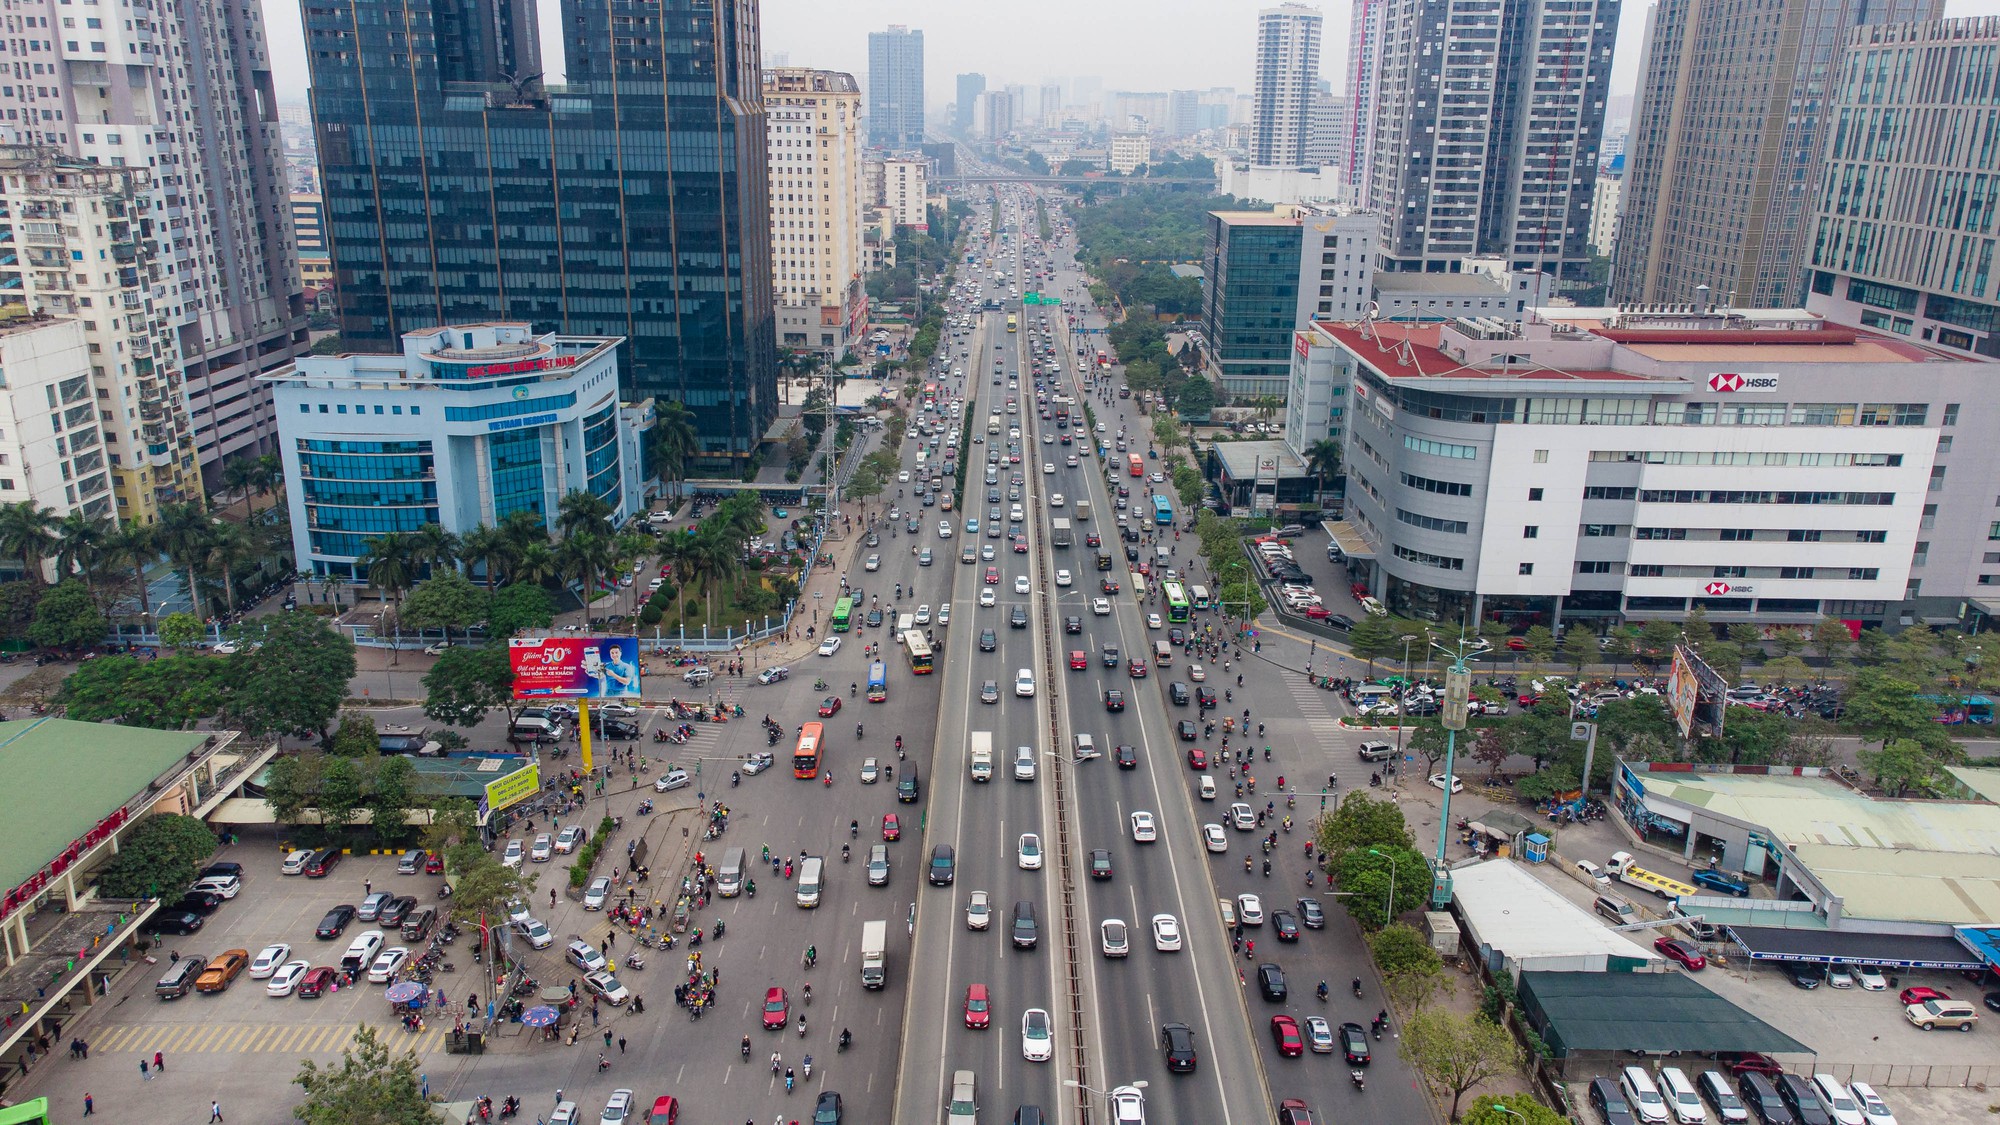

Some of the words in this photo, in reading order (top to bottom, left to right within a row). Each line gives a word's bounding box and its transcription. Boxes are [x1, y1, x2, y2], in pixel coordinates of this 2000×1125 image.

[556, 356, 576, 366] NAM
[1746, 378, 1777, 387] HSBC
[488, 419, 522, 431] VIETNAM
[523, 413, 558, 426] REGISTER
